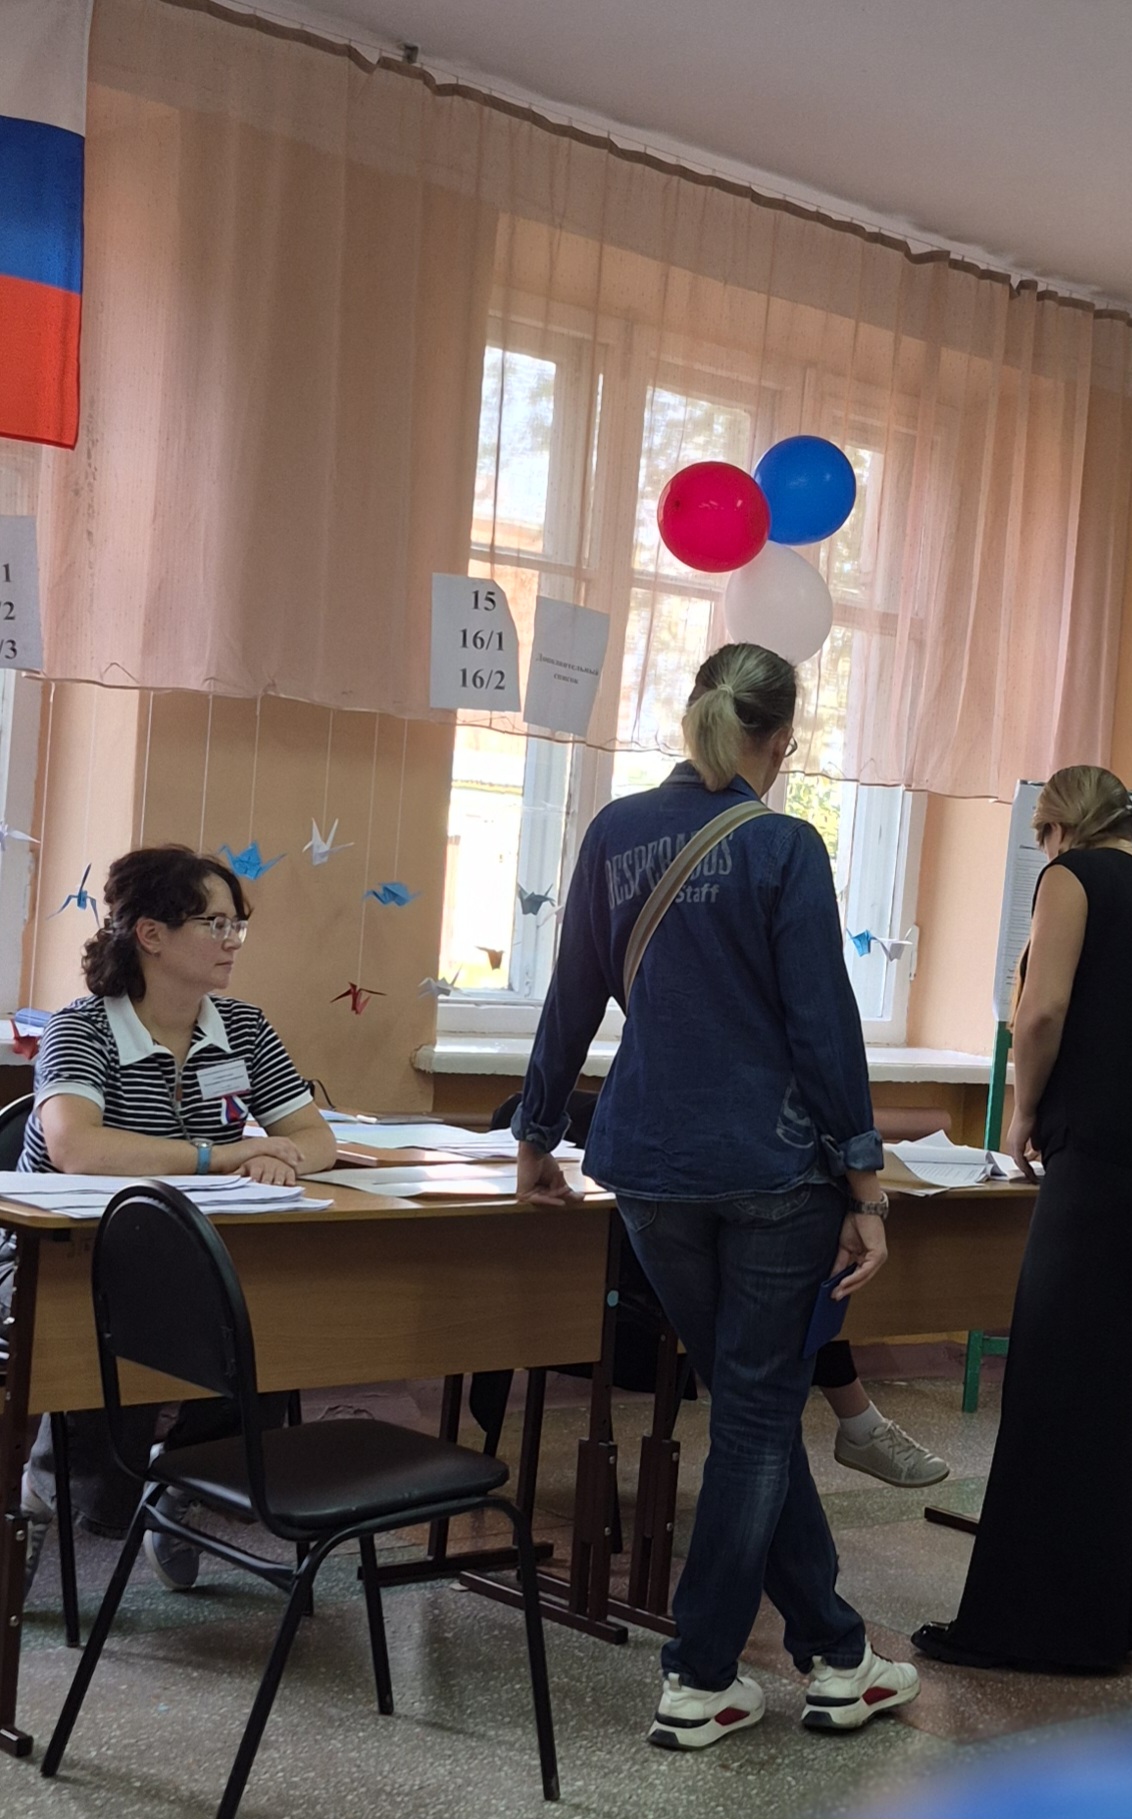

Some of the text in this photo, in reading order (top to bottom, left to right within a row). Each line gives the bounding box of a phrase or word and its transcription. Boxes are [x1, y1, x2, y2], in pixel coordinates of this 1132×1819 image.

[0, 601, 15, 620] 2
[472, 589, 497, 611] 15
[460, 628, 504, 651] 16/1
[459, 668, 506, 690] 16/2
[605, 830, 734, 910] DESPEROS
